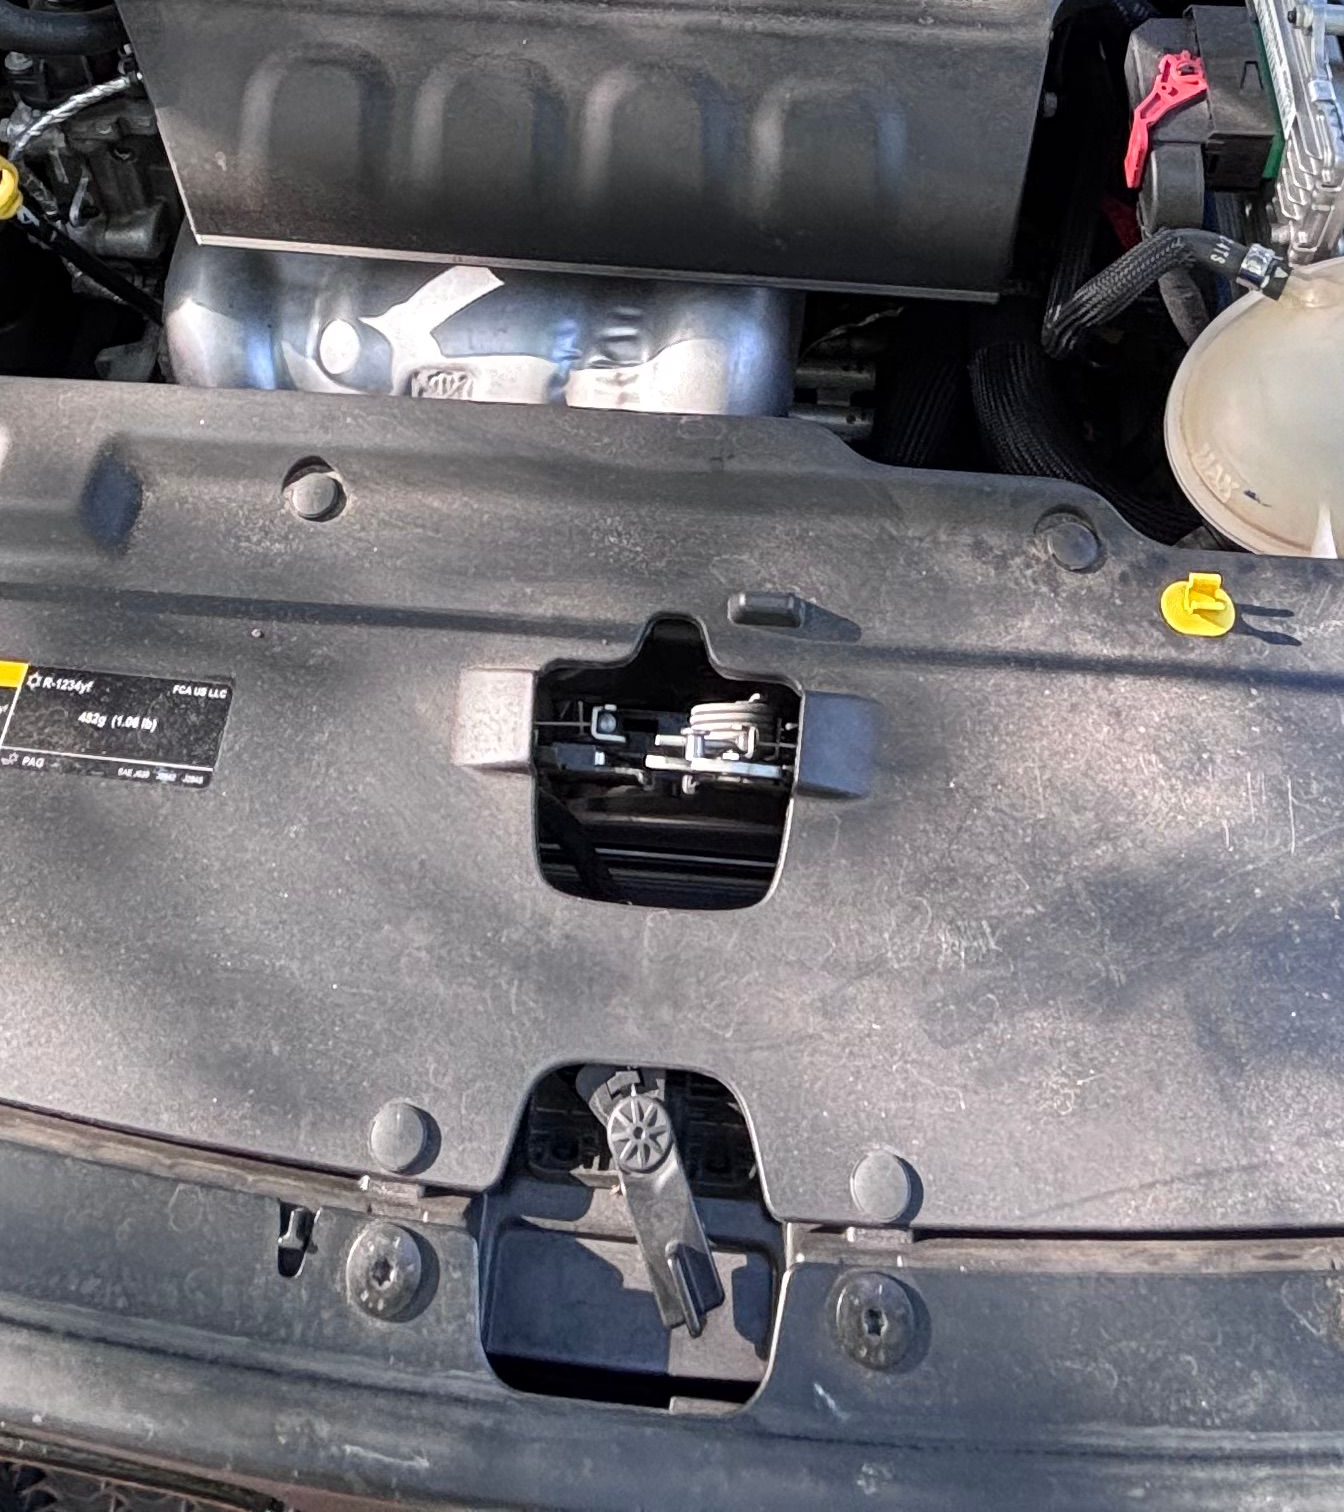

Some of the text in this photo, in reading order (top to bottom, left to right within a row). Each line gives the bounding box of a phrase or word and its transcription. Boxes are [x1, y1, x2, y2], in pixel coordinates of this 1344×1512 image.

[43, 676, 95, 695] R-1234yf
[173, 684, 227, 699] FCA US LLC
